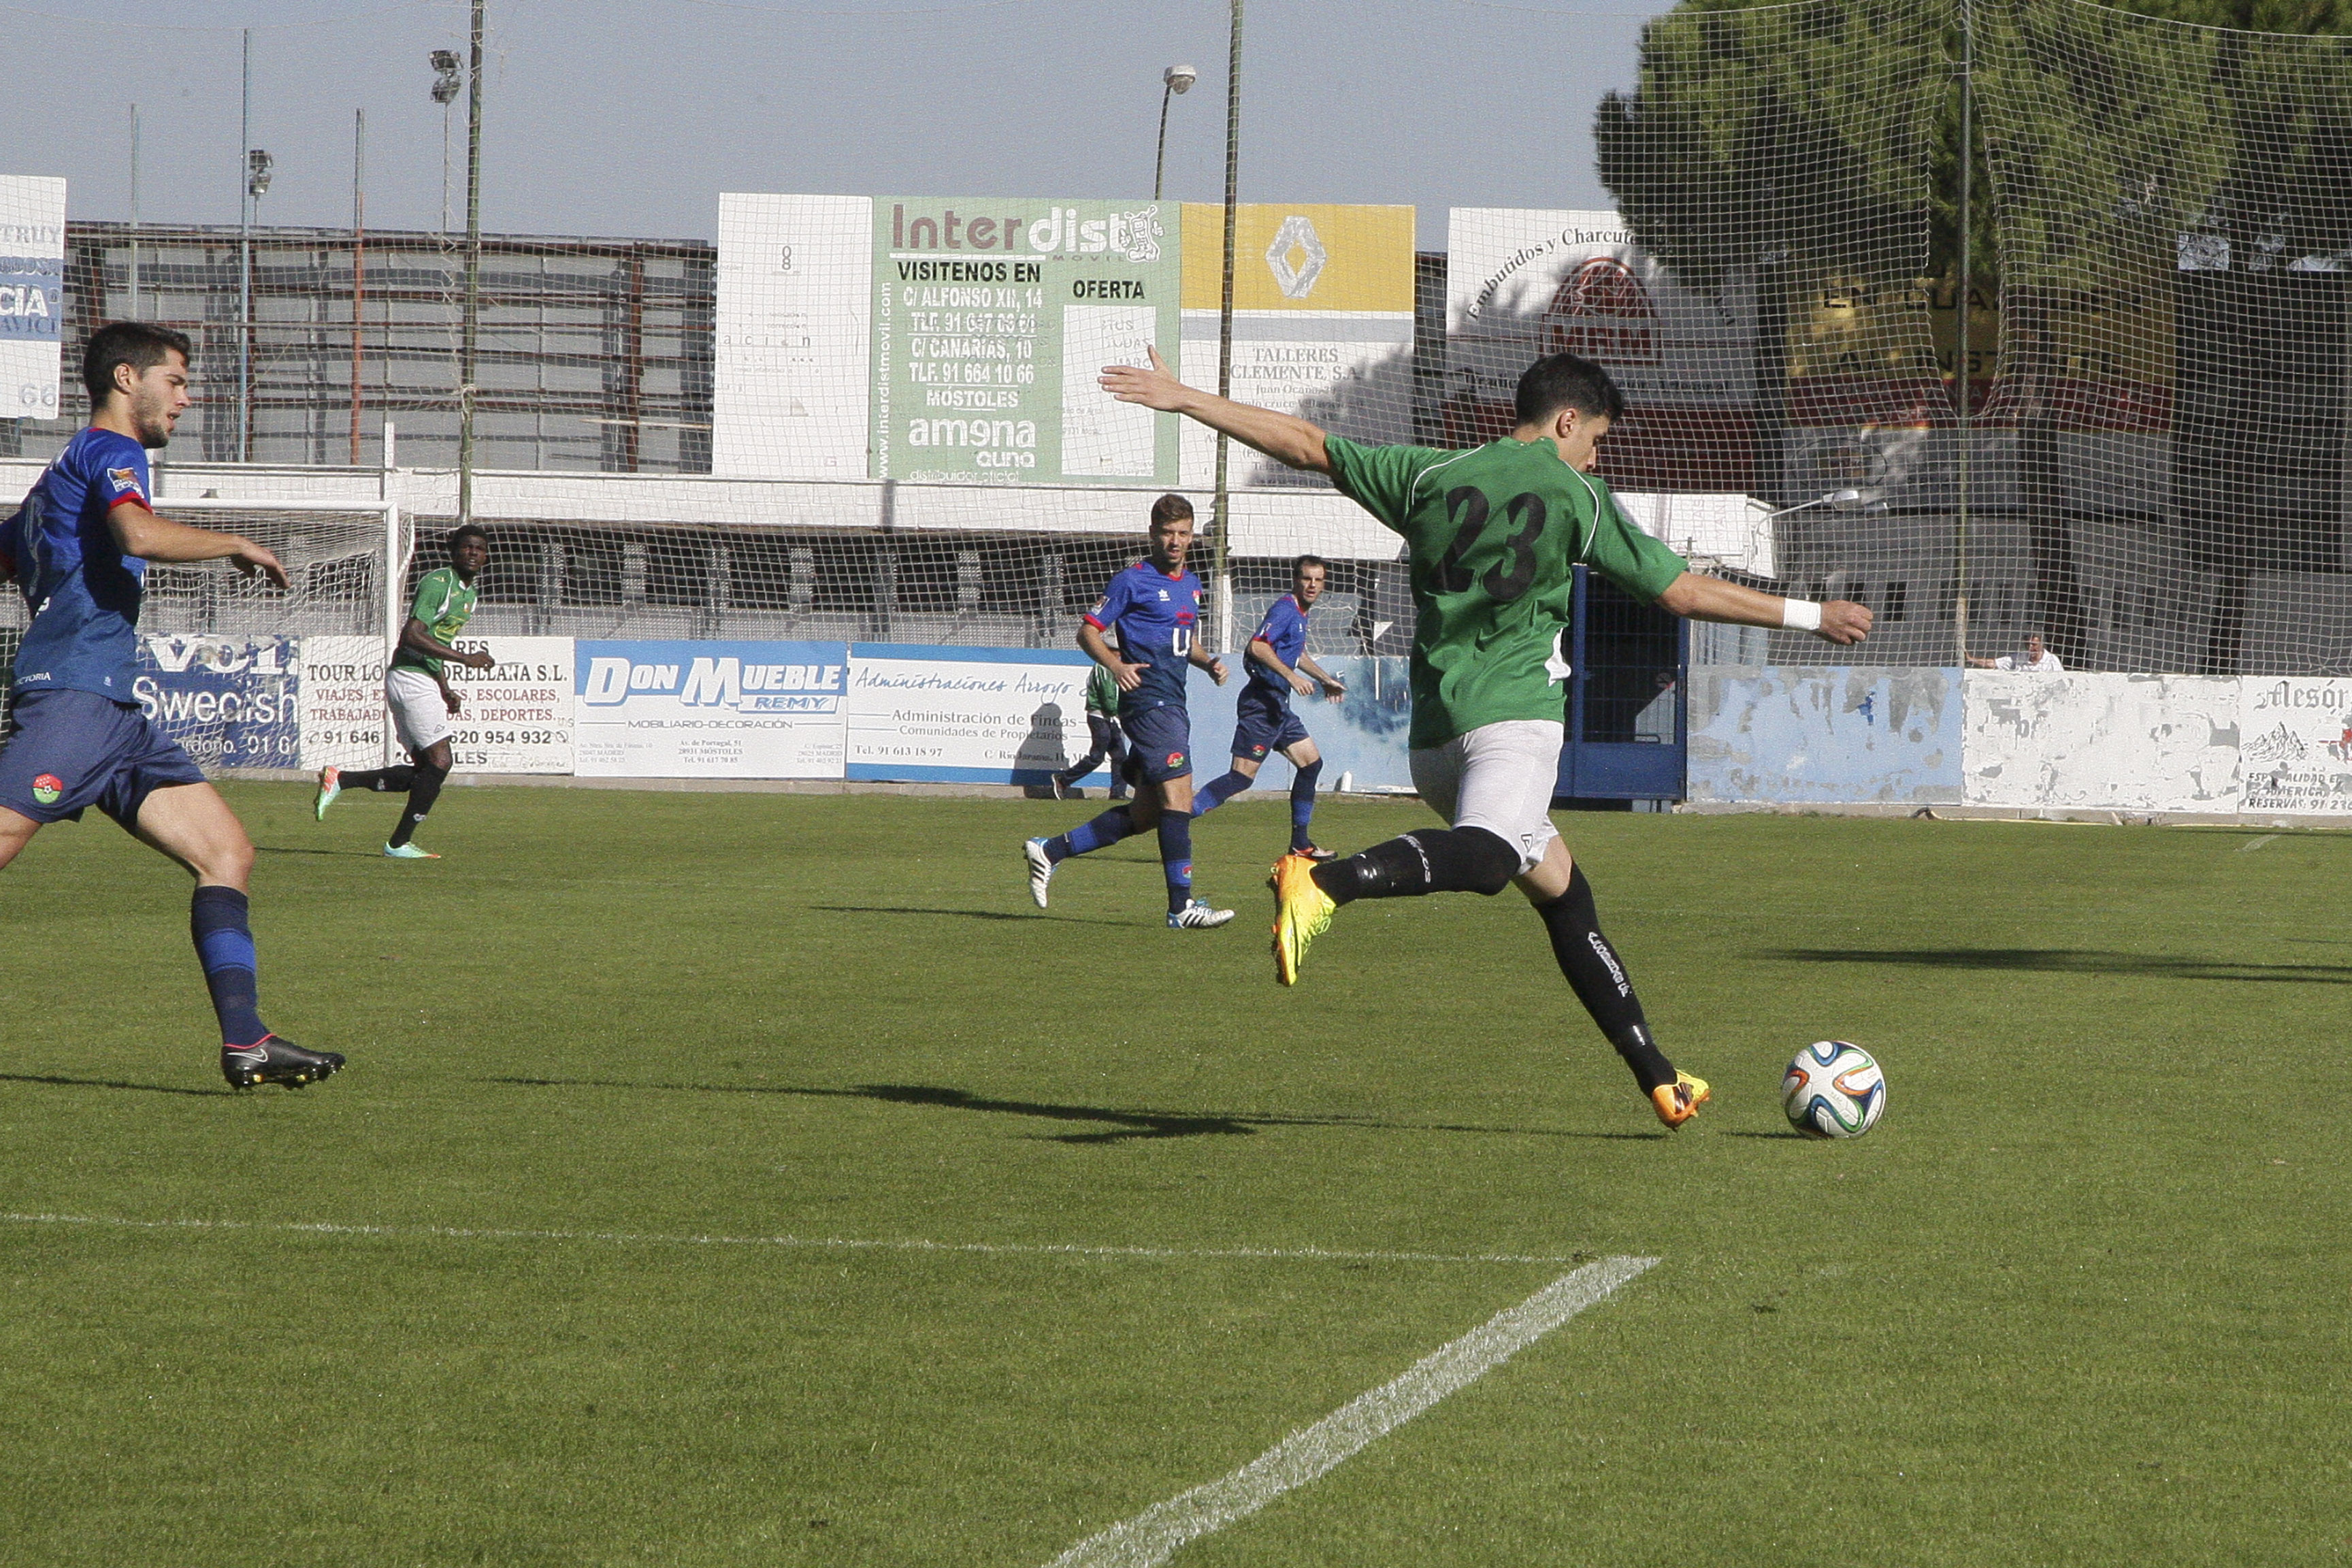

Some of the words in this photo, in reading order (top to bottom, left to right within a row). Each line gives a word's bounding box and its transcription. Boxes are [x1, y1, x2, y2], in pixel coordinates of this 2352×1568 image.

[893, 204, 1127, 252] Interdist
[898, 261, 1007, 282] VISITENOS
[1014, 263, 1041, 282] EN
[1467, 242, 1544, 320] Embutidos
[1547, 239, 1556, 253] y
[921, 287, 992, 308] ALFONSO
[1026, 287, 1043, 308] 14
[1073, 280, 1145, 299] OFERTA
[1015, 340, 1032, 359] 10
[1253, 348, 1339, 363] TALLERES
[877, 282, 892, 478] www.interdistmovil.com
[909, 362, 938, 382] TLF.
[943, 363, 958, 382] 91
[964, 363, 991, 383] 664
[995, 363, 1013, 383] 10
[1017, 364, 1034, 384] 66
[1230, 364, 1327, 381] CLEMENTE,
[926, 385, 1019, 408] MÓSTOLES
[1429, 485, 1547, 600] 23
[308, 665, 358, 681] TOUR
[536, 664, 568, 681] S.L.
[583, 657, 679, 706] DON
[679, 657, 842, 706] MUEBLE
[316, 689, 368, 702] VIAJES,
[476, 689, 560, 702] ESCOLARES,
[855, 667, 1007, 693] Administraciones
[1015, 672, 1075, 705] Arroyo
[754, 696, 828, 710] REMY
[310, 708, 385, 721] TRABAJAD
[627, 719, 794, 729] MOBILIARIO-DECORACIÓN
[892, 709, 1001, 725] Administración
[1007, 713, 1025, 726] de
[1031, 714, 1077, 728] Fincas
[324, 731, 342, 744] 91
[350, 731, 380, 744] 646
[485, 731, 515, 744] 954
[521, 731, 551, 744] 932
[899, 725, 979, 738] Comunidades
[982, 728, 996, 738] de
[1000, 728, 1068, 742] Propietarios
[855, 745, 875, 755] Tel.
[877, 745, 892, 755] 91
[892, 745, 911, 756] 613
[914, 746, 926, 756] 18
[928, 747, 943, 757] 97
